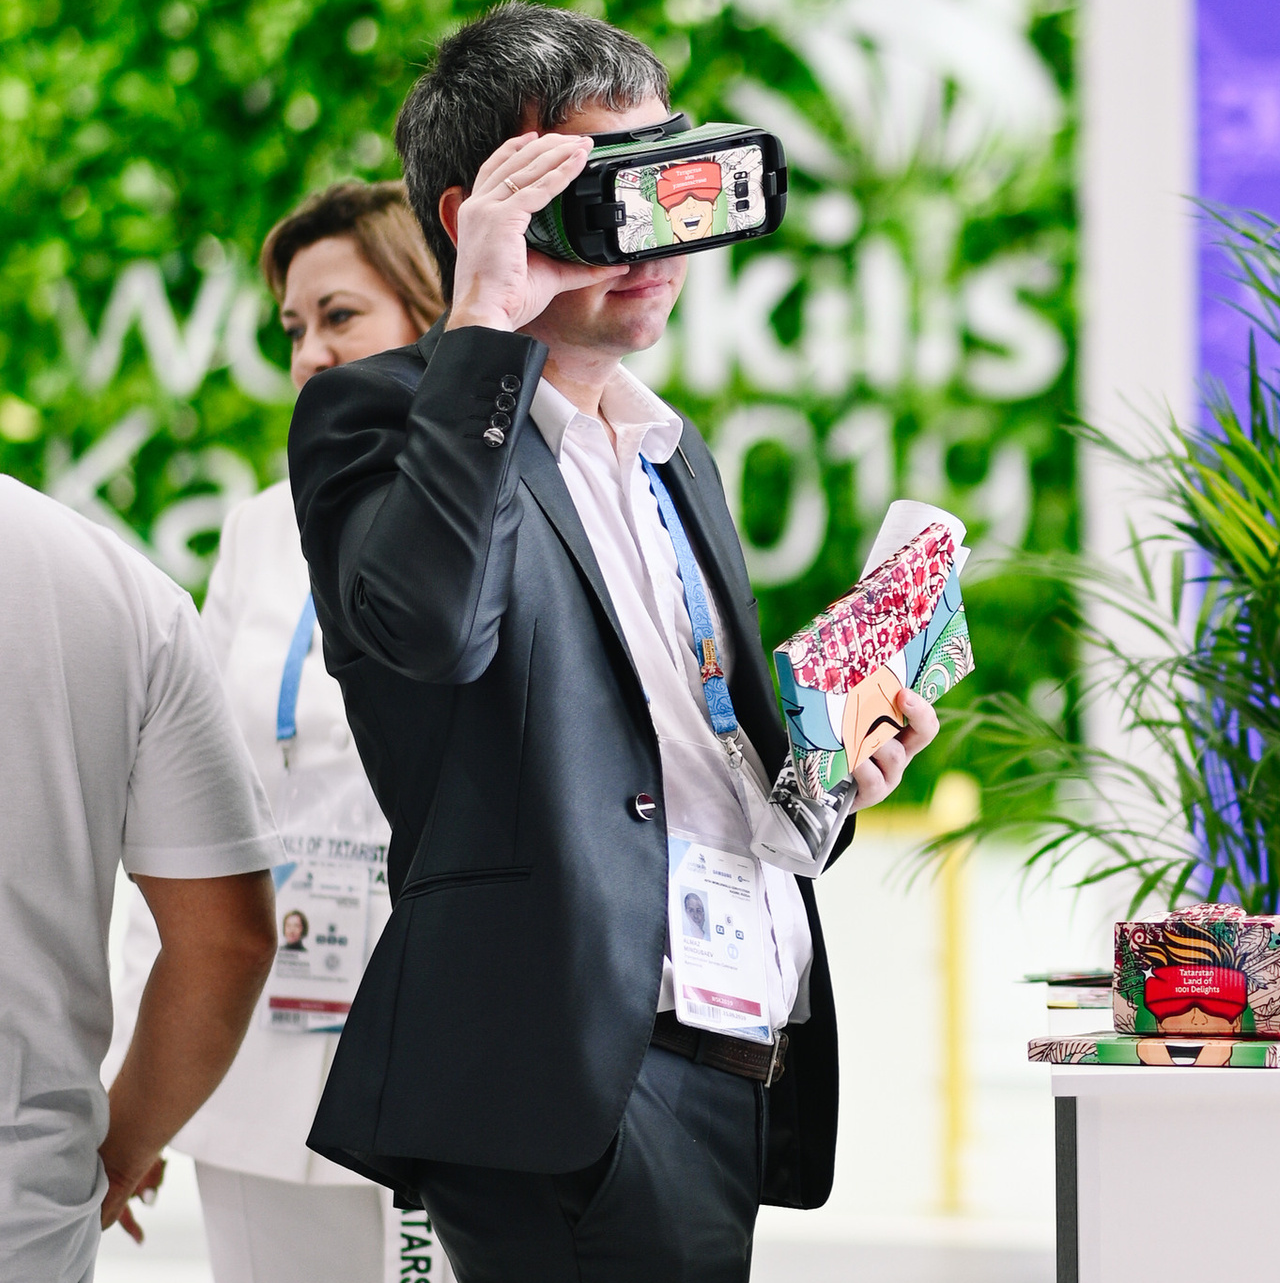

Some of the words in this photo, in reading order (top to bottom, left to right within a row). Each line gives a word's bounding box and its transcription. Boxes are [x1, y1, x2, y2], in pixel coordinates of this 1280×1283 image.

[1179, 968, 1215, 977] Tatarstan
[1183, 977, 1202, 985] Land
[1203, 976, 1213, 985] of
[1190, 985, 1220, 995] Delights
